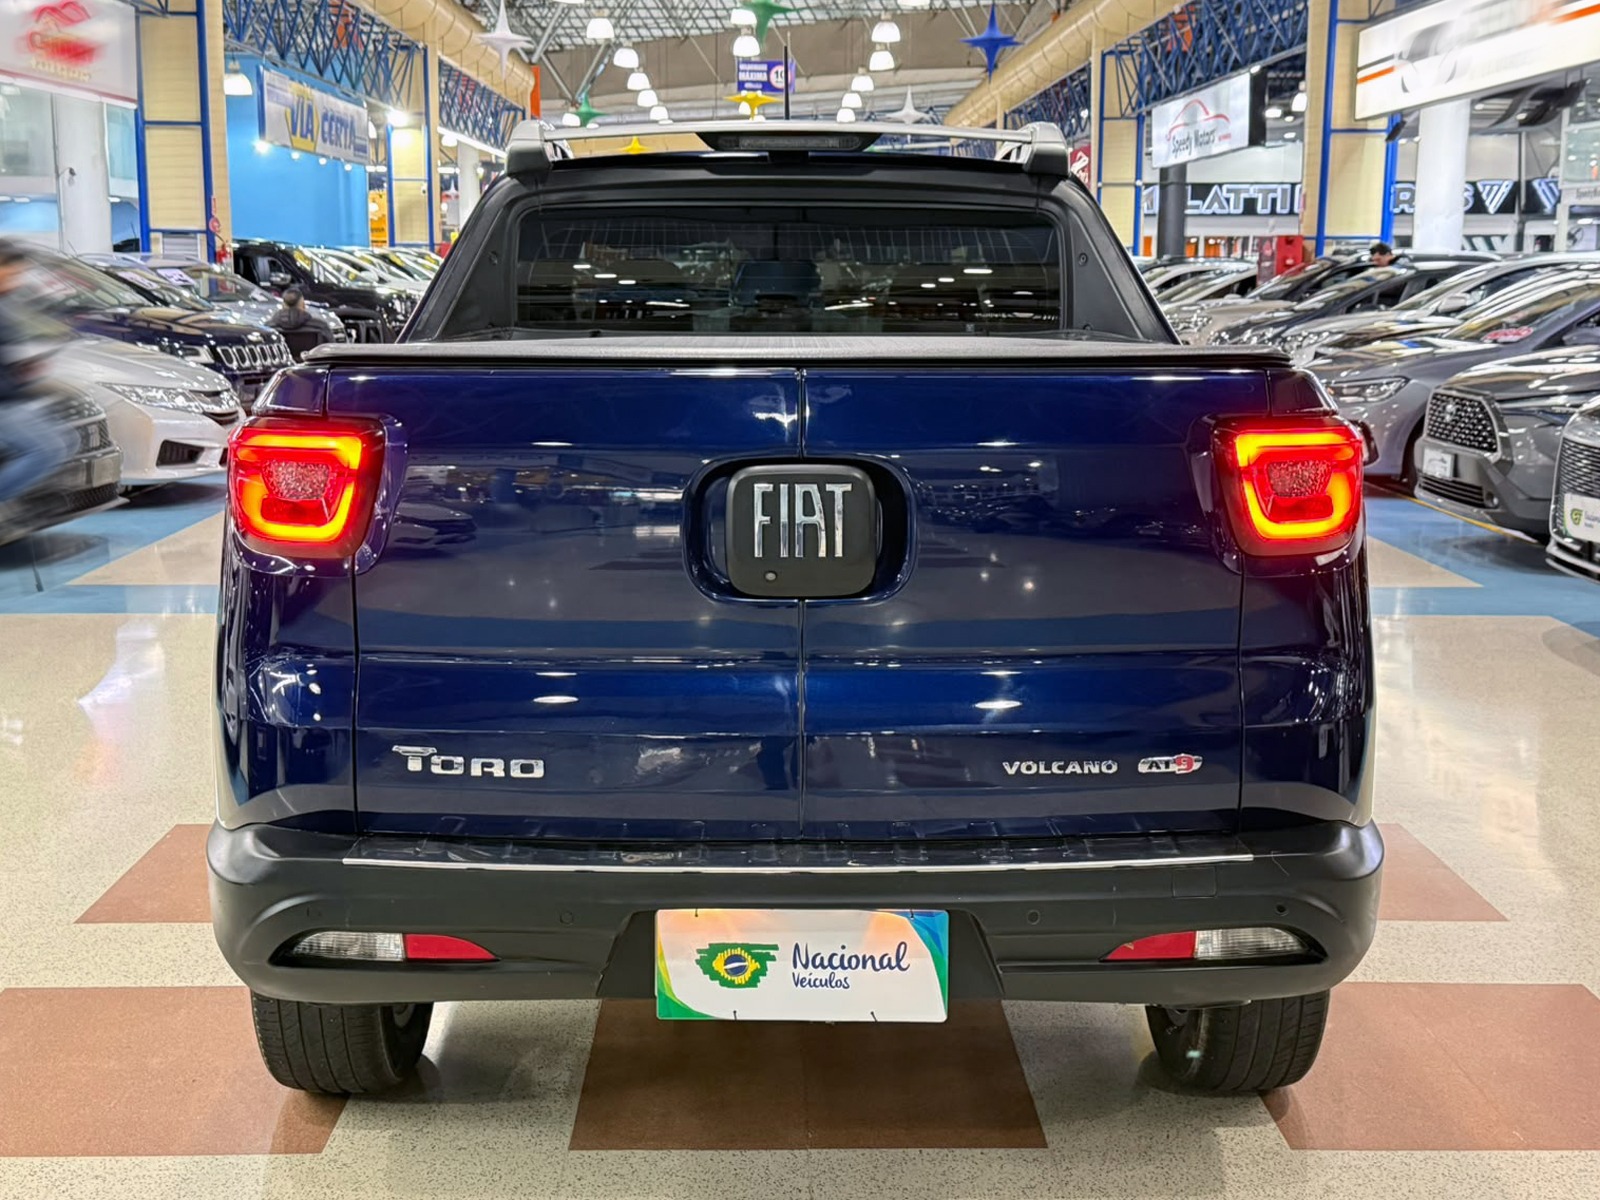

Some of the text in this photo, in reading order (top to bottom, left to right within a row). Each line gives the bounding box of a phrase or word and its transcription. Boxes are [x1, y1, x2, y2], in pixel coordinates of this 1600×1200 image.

[290, 94, 356, 150] VIA CERTA
[1172, 131, 1193, 159] Speedy
[754, 484, 852, 558] FIAT
[392, 745, 545, 778] TORO
[1002, 753, 1198, 775] VOLCANO AT9
[792, 941, 910, 972] Nacional
[792, 971, 851, 989] Veículos
